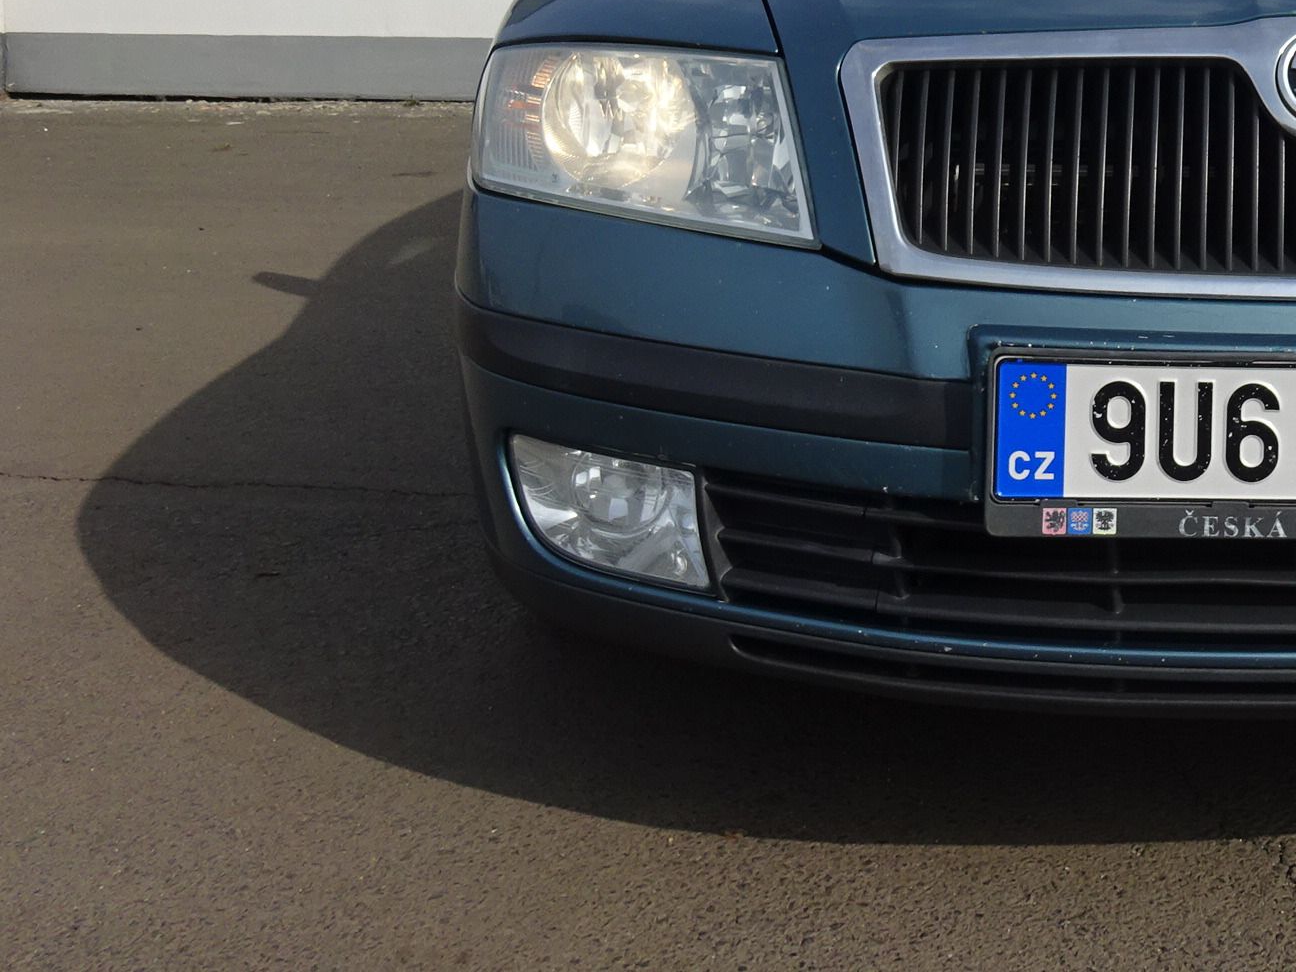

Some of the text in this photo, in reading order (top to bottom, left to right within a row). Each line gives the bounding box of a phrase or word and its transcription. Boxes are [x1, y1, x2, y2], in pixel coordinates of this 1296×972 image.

[1090, 379, 1281, 484] 9U6
[1007, 450, 1055, 481] CZ
[1178, 509, 1288, 539] ČESKÁ
